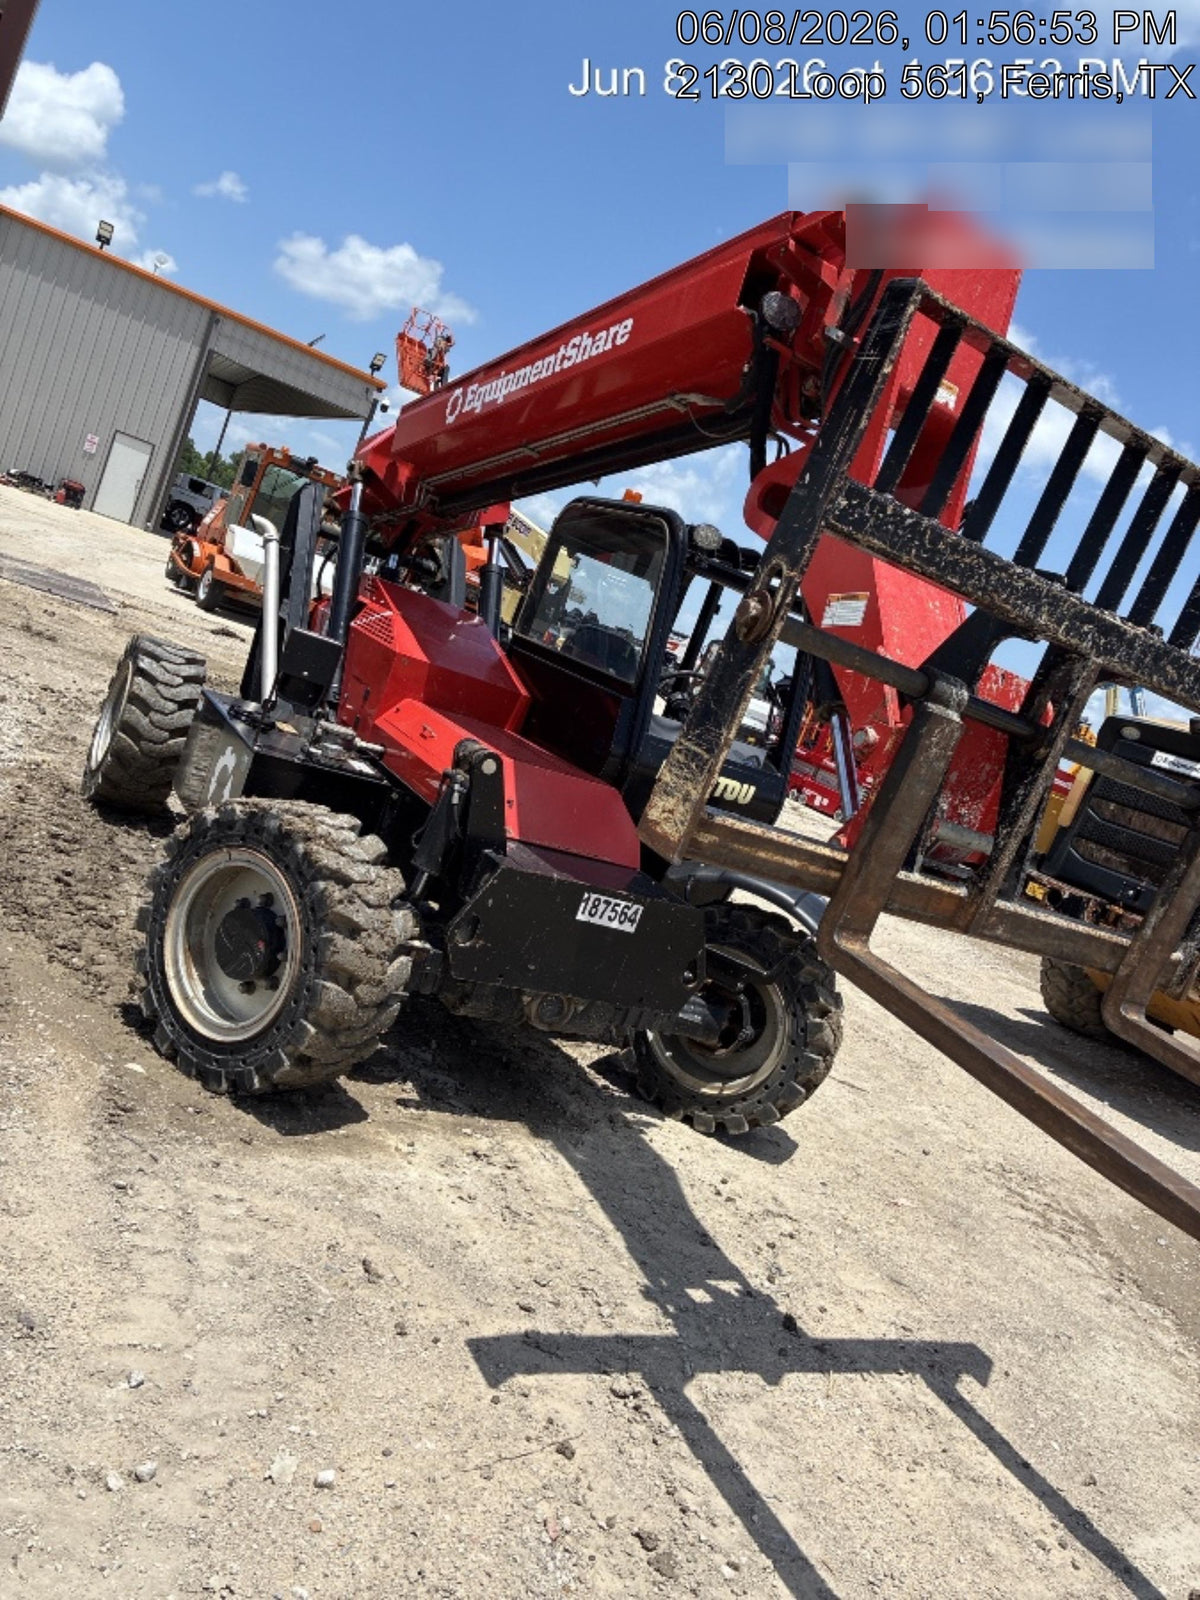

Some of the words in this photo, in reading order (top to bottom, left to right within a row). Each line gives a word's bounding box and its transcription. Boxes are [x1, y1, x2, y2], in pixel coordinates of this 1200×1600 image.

[462, 317, 634, 413] EquipmentShare
[713, 776, 757, 805] TOU
[580, 895, 641, 927] 187564
